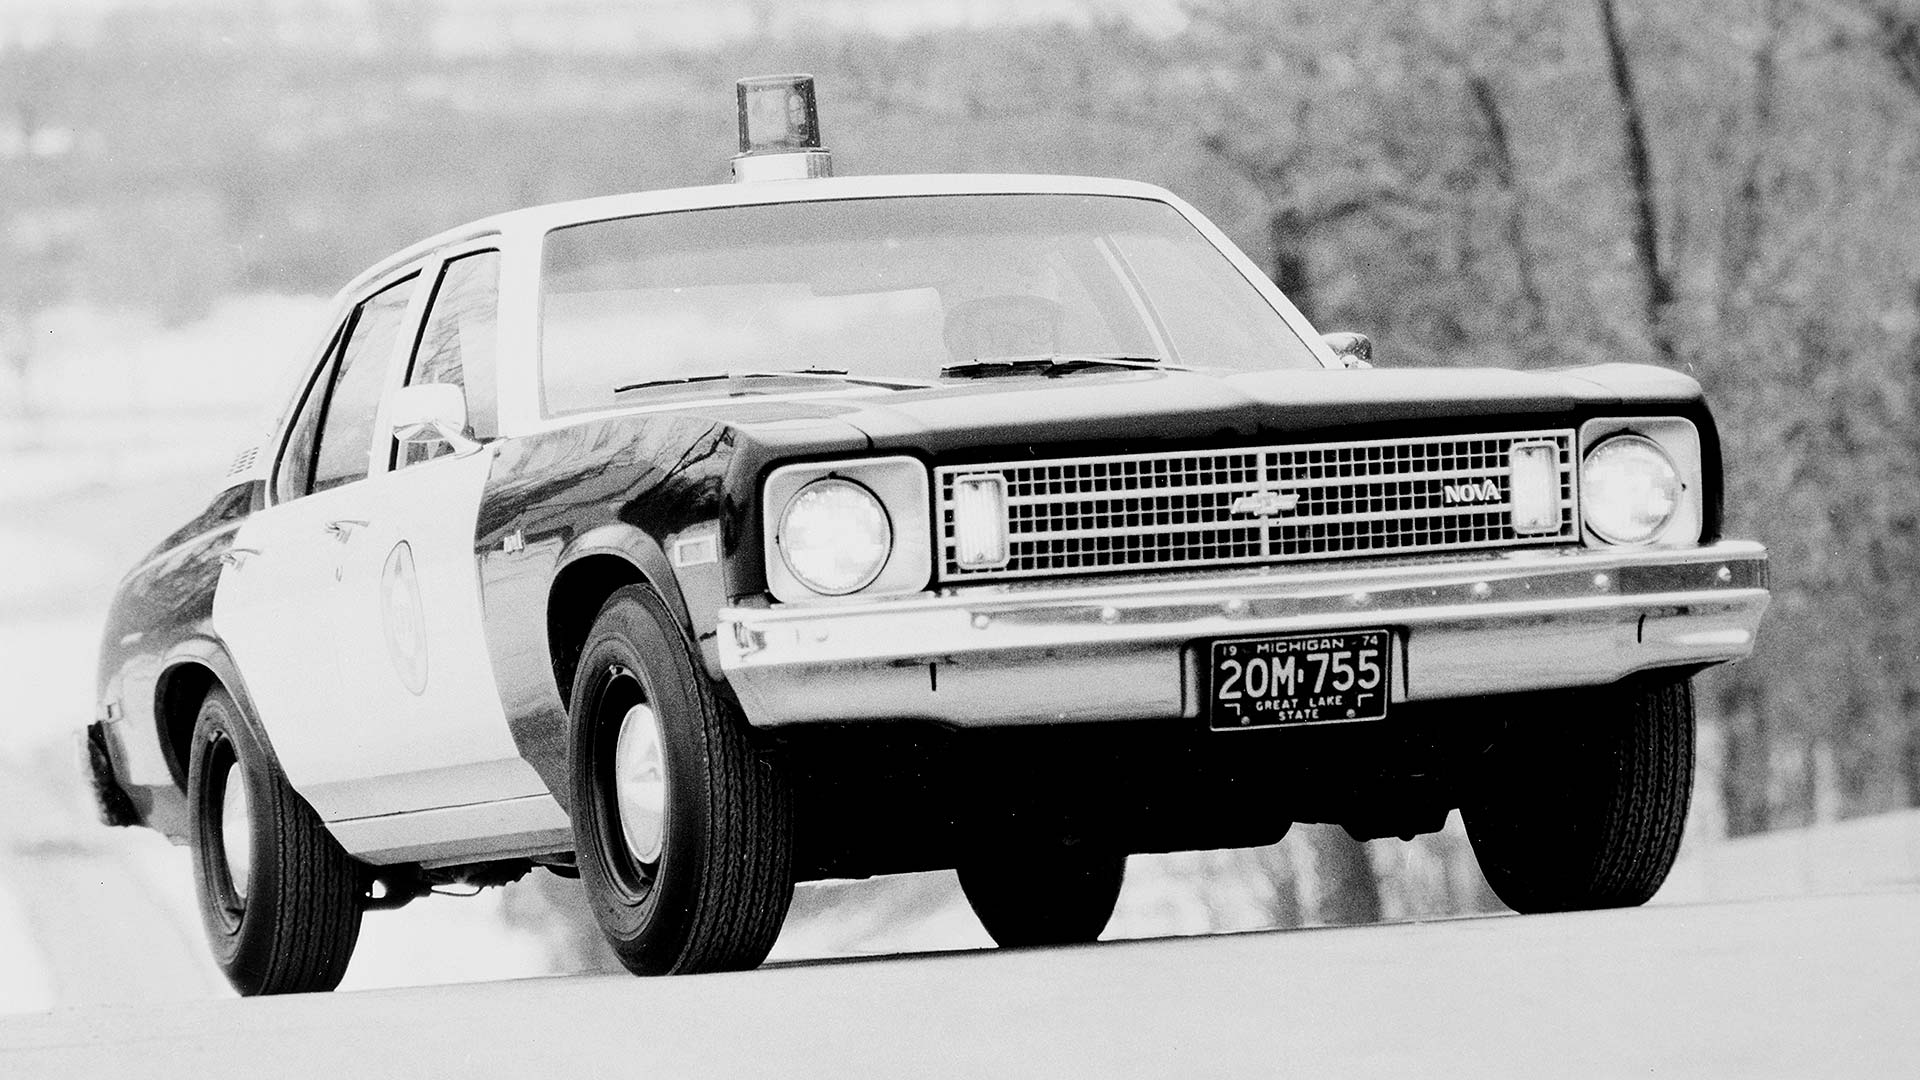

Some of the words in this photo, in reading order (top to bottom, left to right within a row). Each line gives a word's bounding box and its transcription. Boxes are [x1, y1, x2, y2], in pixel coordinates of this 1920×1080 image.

[1444, 479, 1502, 503] NOVA
[1222, 645, 1238, 657] 19
[1256, 638, 1345, 654] MICHIGAN
[1362, 635, 1379, 646] 74
[1255, 698, 1299, 712] GREAT
[1309, 695, 1343, 708] LAKE
[1278, 708, 1320, 721] STATE
